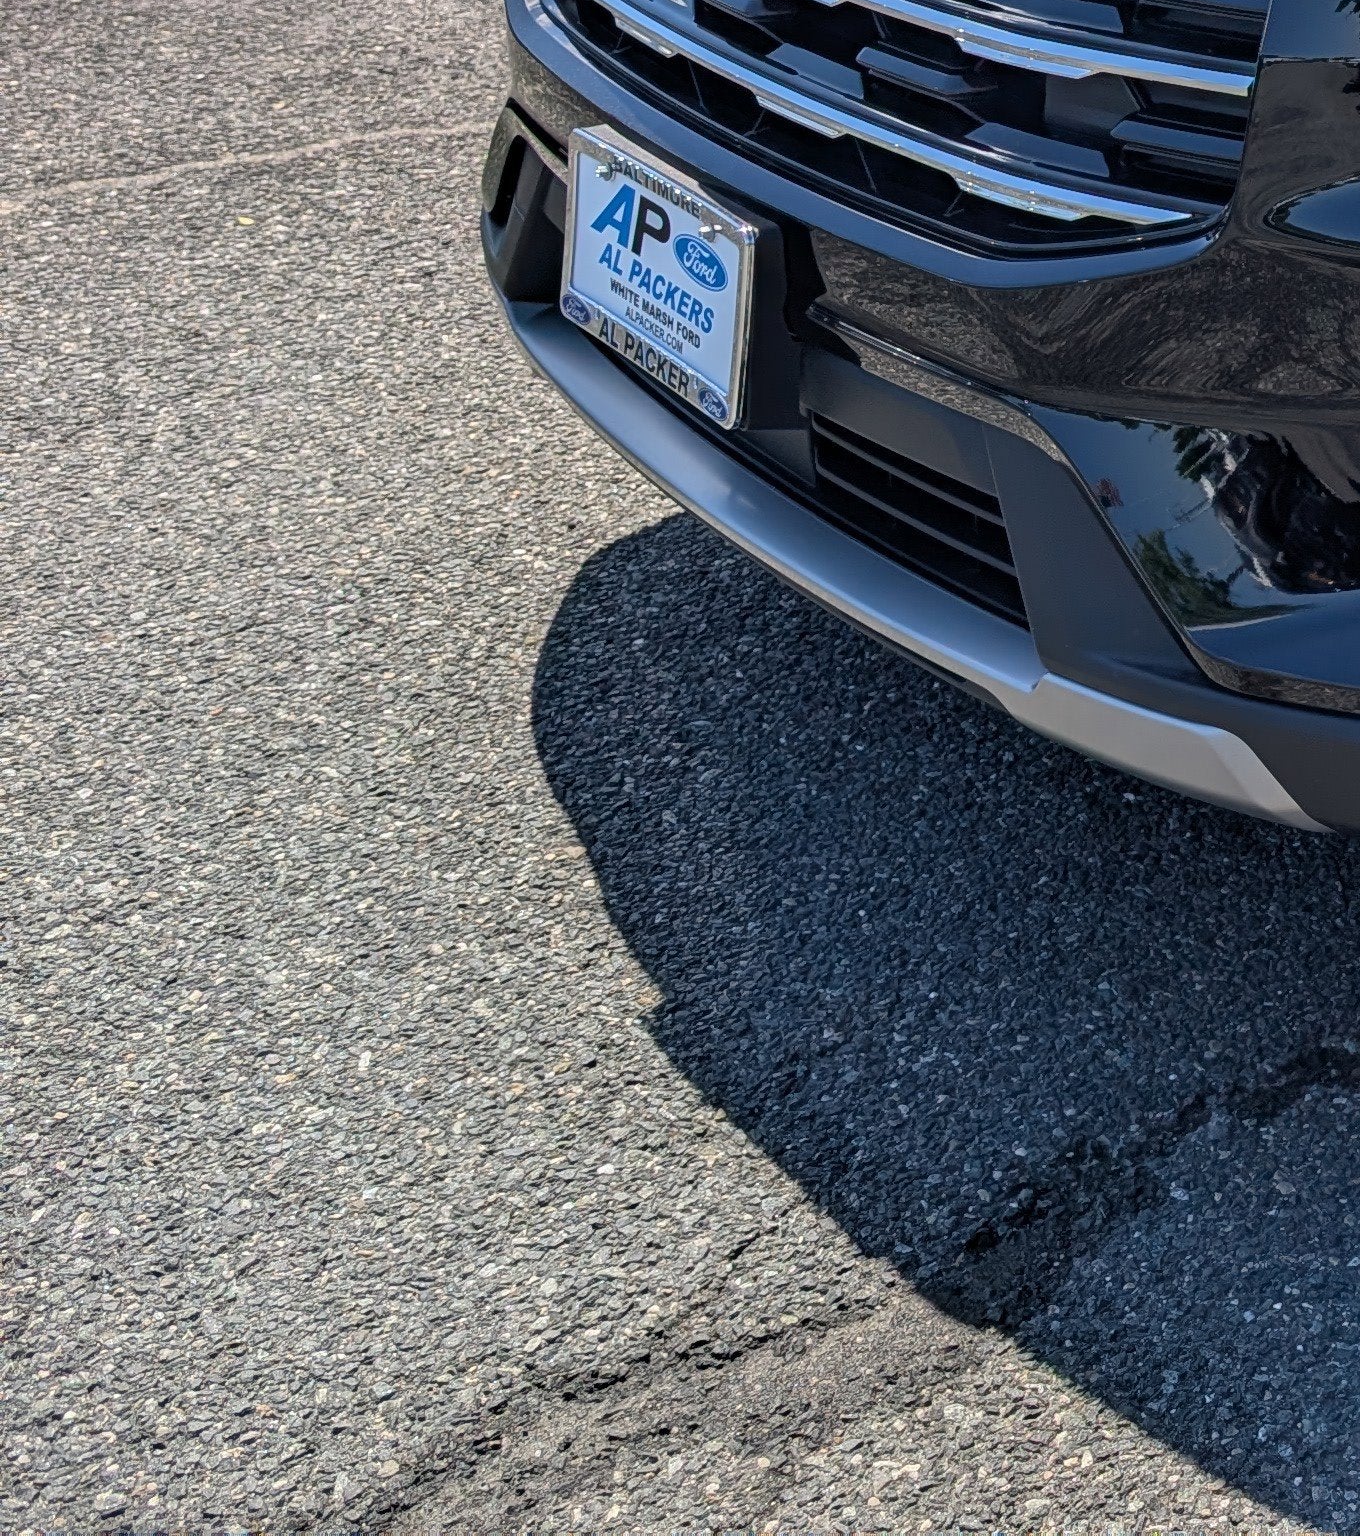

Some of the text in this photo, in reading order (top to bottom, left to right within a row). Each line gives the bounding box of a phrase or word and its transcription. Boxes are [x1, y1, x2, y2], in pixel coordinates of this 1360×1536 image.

[590, 183, 671, 257] AP
[613, 155, 702, 220] BALTIMORE
[599, 243, 715, 334] AL PACKERS
[683, 241, 718, 285] Ford
[610, 278, 701, 349] WHITE MARSH FORD
[625, 306, 684, 355] ALPACKER.COM
[599, 315, 690, 398] AL PACKER
